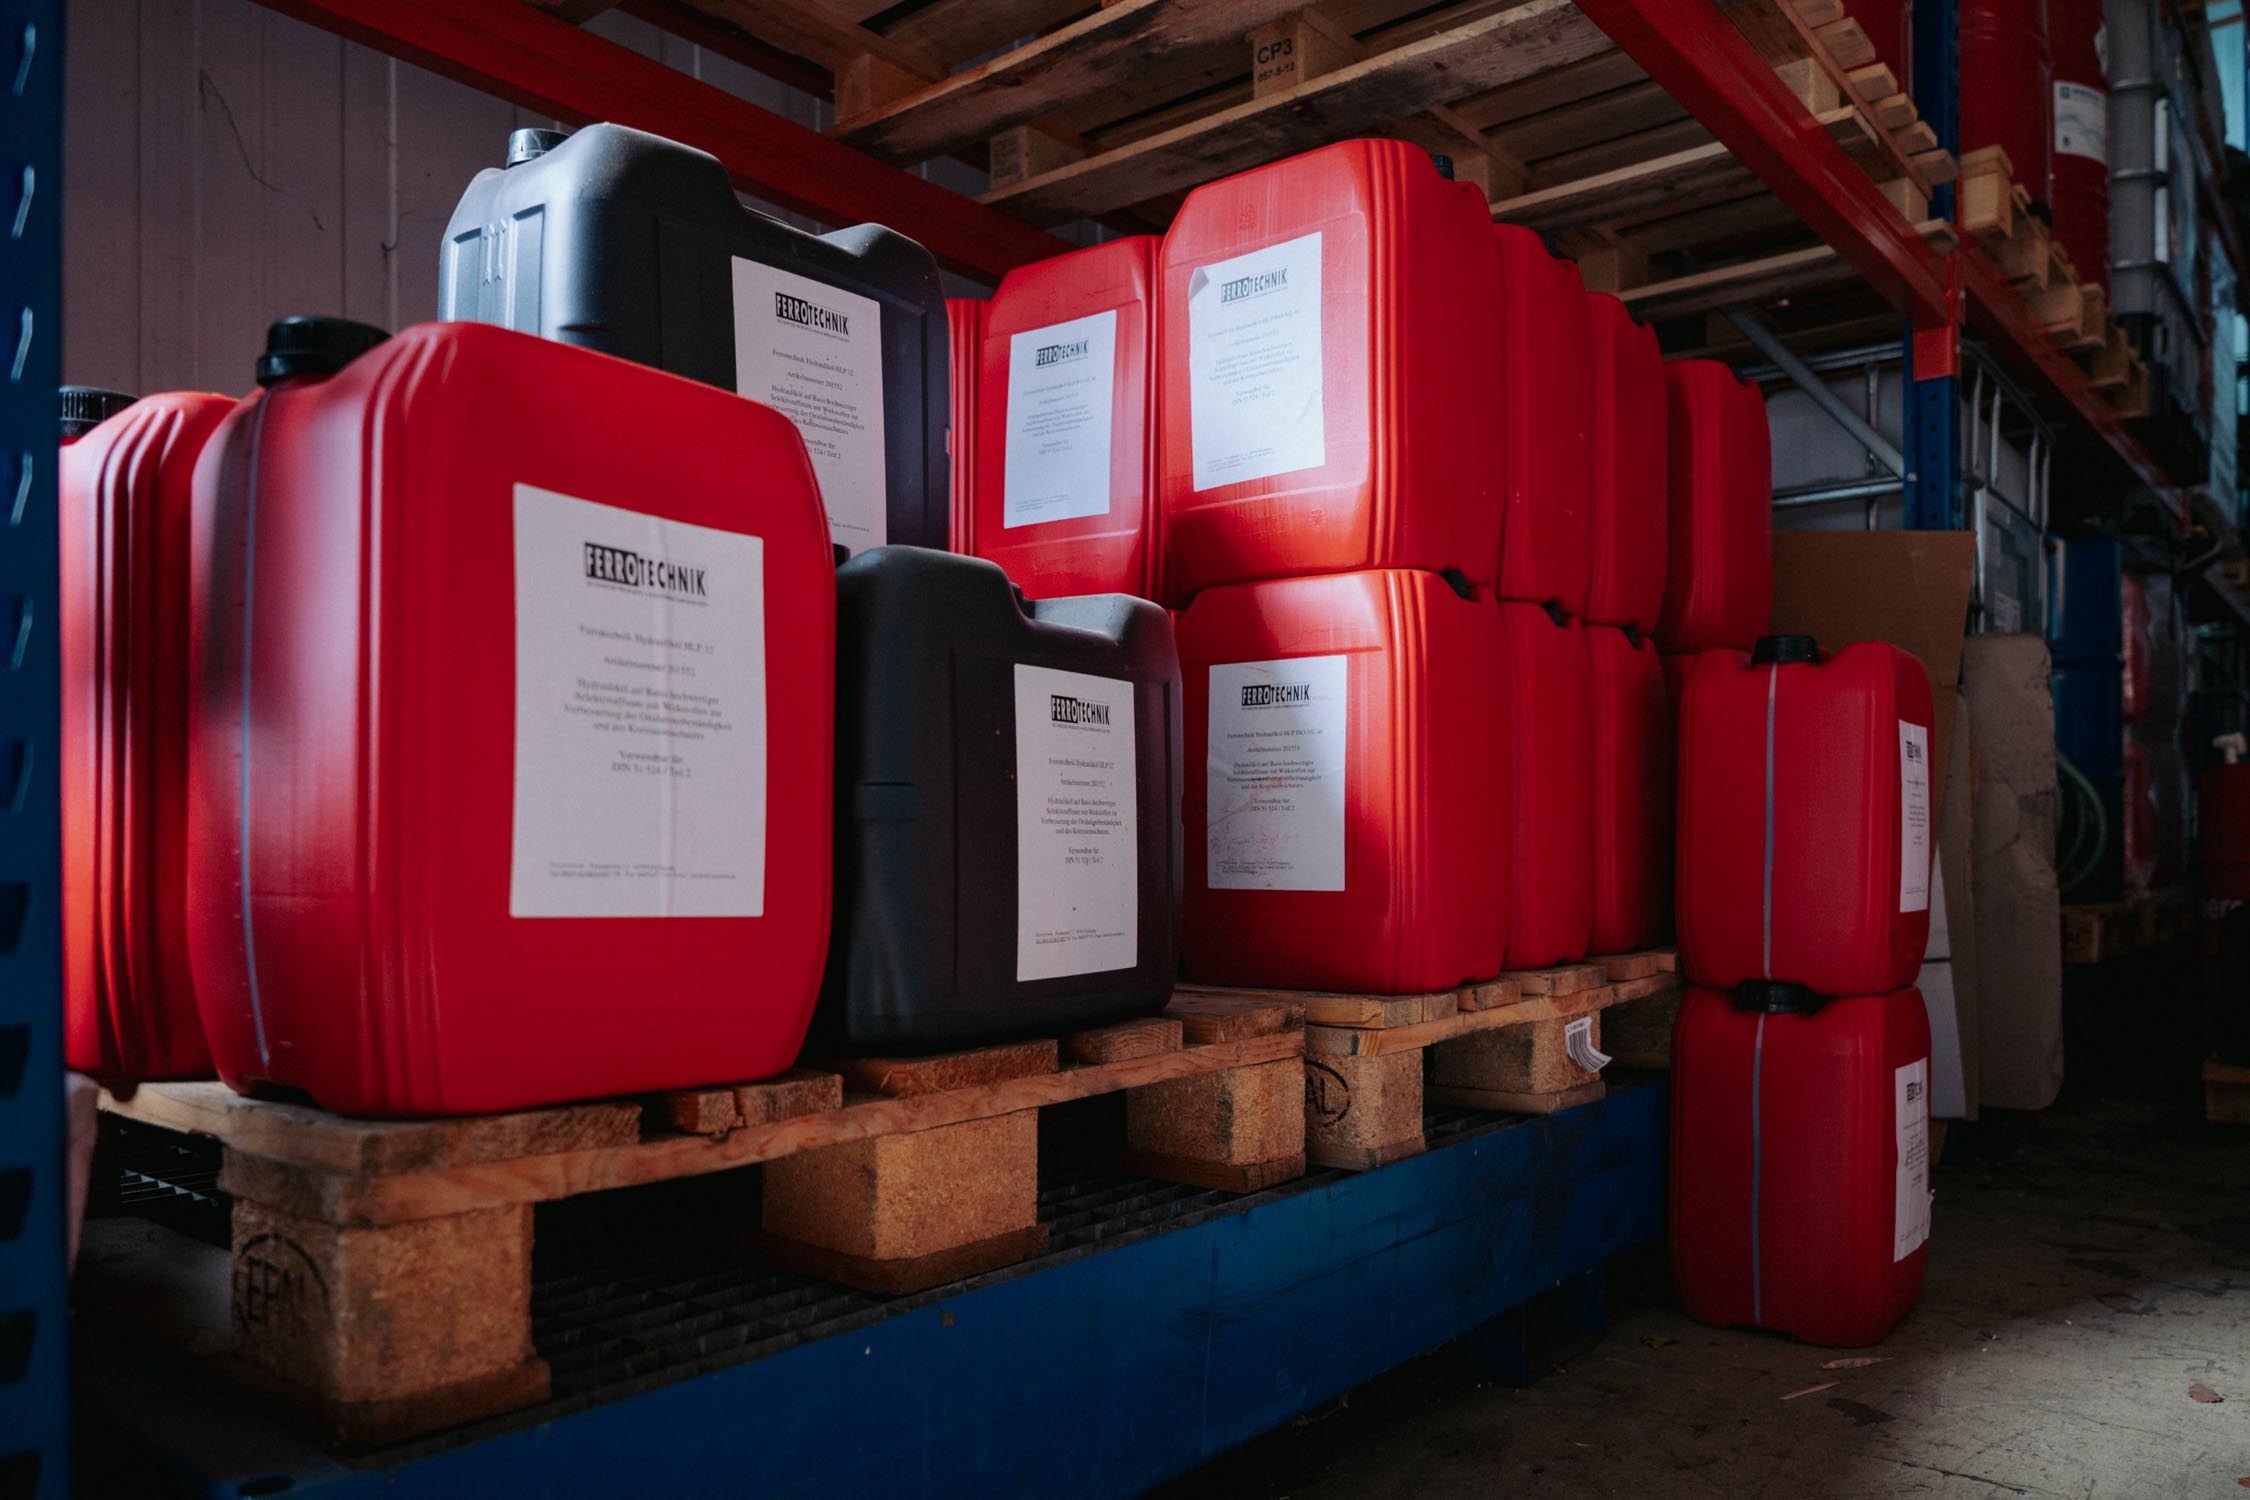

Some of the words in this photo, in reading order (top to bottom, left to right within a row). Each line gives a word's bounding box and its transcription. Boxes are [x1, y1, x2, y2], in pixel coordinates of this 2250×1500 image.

[1257, 38, 1293, 64] CP3
[1221, 268, 1287, 303] FERROTECHNIK
[776, 292, 849, 336] FERROTECHNIK
[1036, 340, 1088, 366] FERROTECHNIK
[585, 543, 706, 597] FERROTECHNIK
[1051, 695, 1109, 726] FERROTECHNIK
[1242, 685, 1310, 706] FERROTECHNIK
